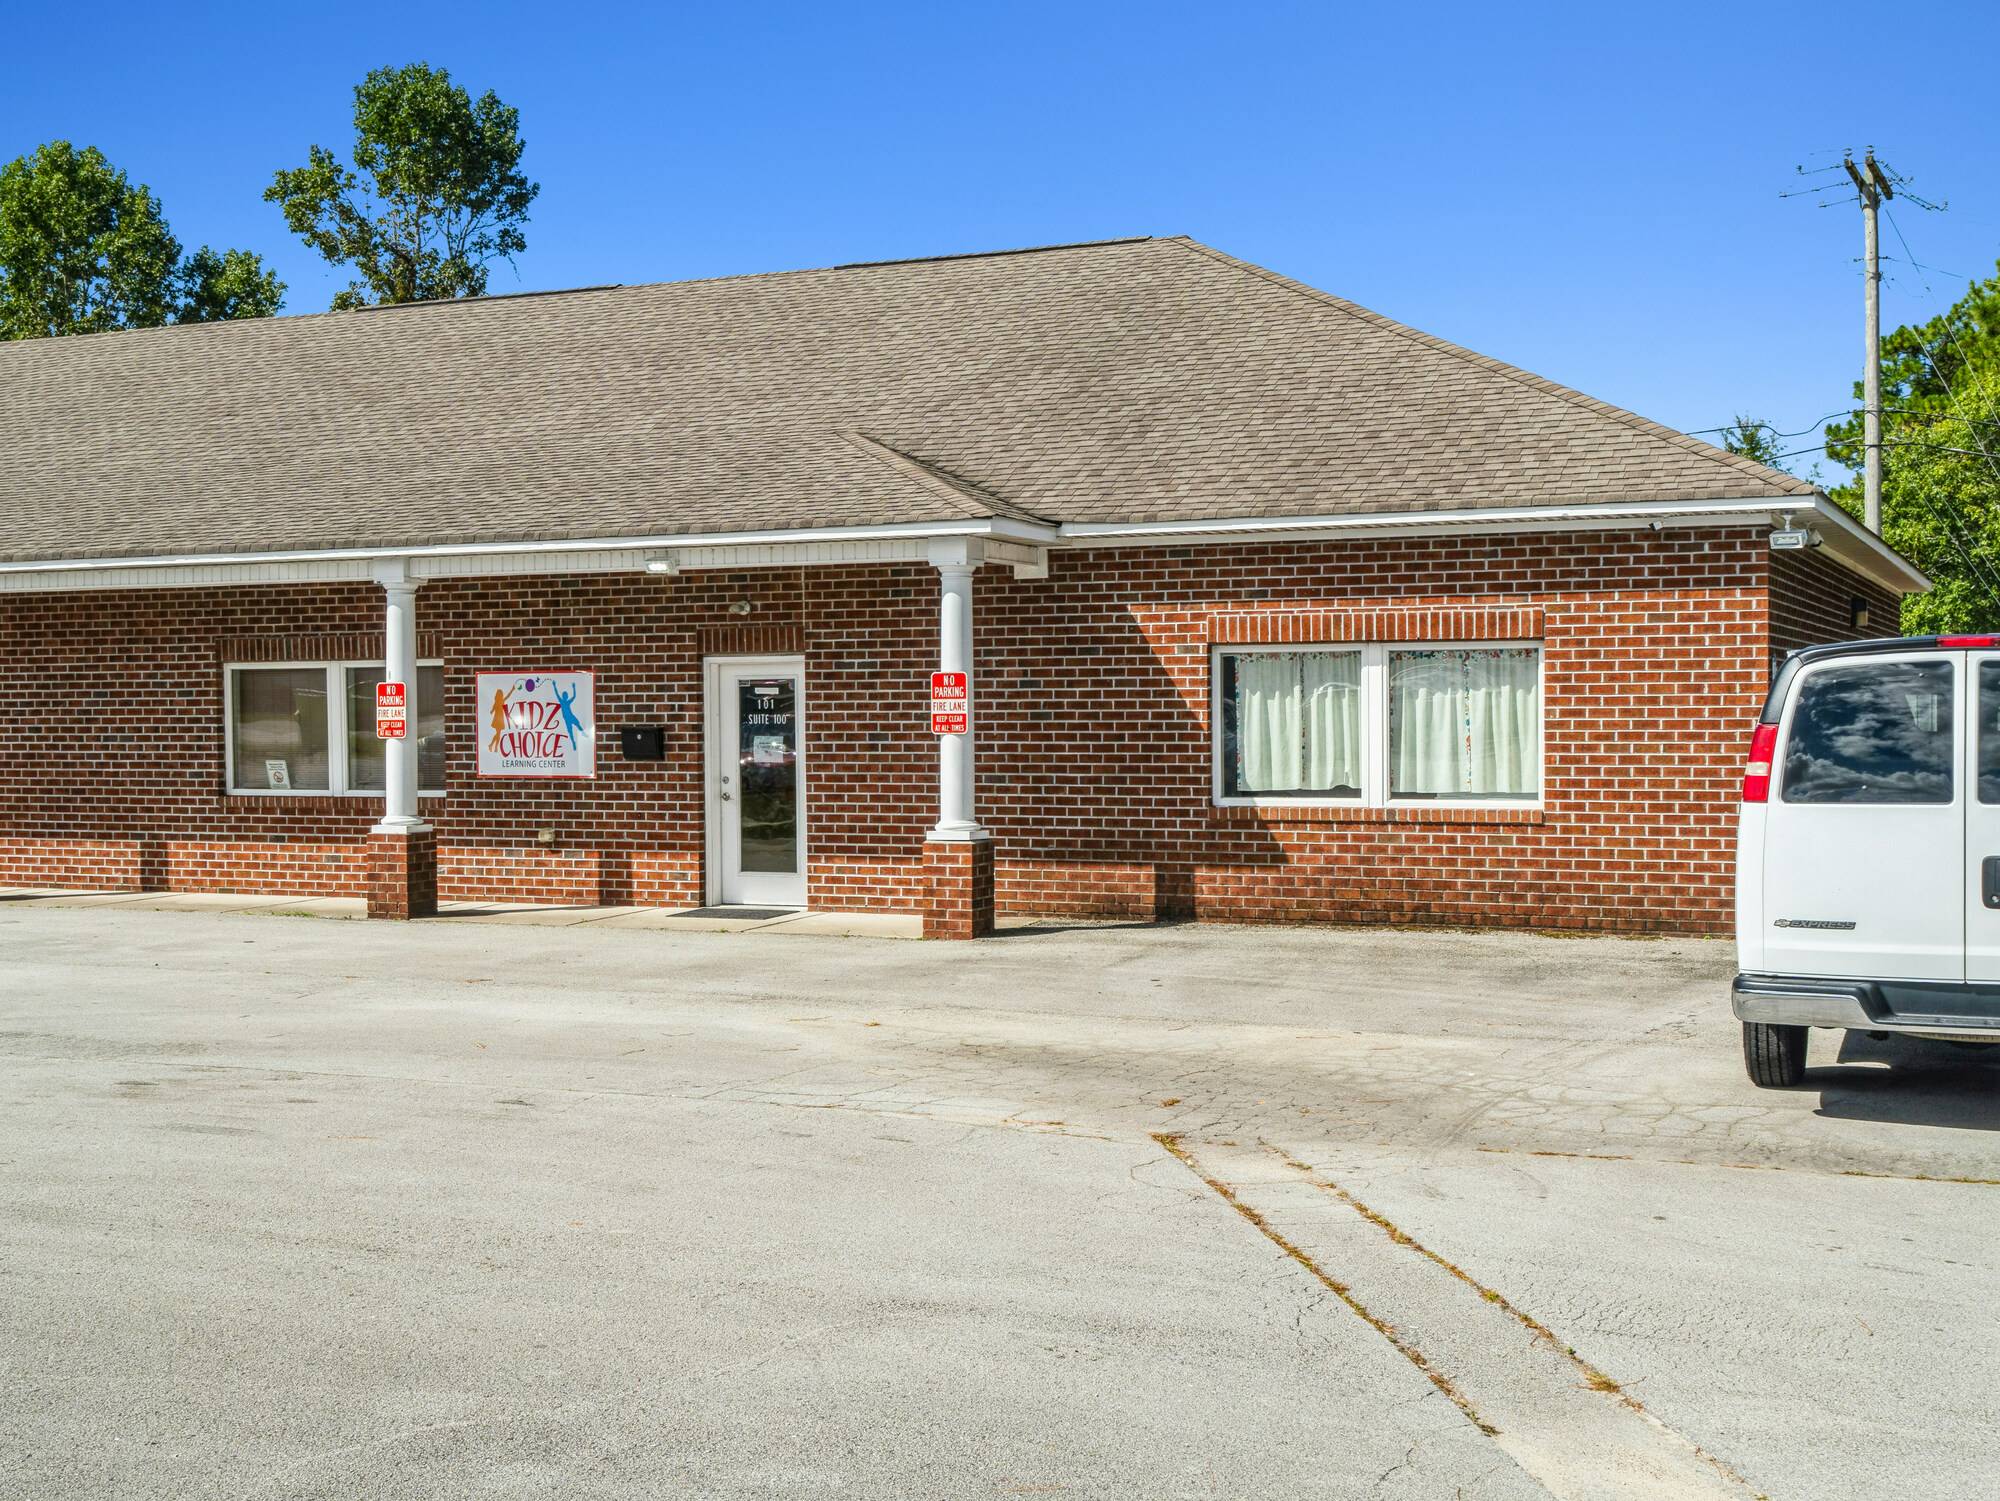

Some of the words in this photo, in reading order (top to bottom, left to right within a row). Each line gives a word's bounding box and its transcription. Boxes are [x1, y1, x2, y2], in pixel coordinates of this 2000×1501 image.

[943, 675, 955, 686] NO
[386, 685, 396, 695] NO
[934, 686, 964, 697] PARKING
[379, 695, 403, 705] PARKING
[757, 699, 774, 710] 101
[933, 702, 946, 711] FIRE
[949, 702, 966, 711] LANE
[378, 709, 389, 718] FIRE
[391, 709, 405, 718] LANE
[502, 701, 562, 730] KIDZ
[748, 714, 769, 725] SUITE
[774, 714, 787, 725] 100
[499, 731, 568, 759] CHOICE
[502, 760, 537, 768] LEARNING
[538, 760, 566, 768] CENTER
[1791, 920, 1856, 929] EXPRESS
